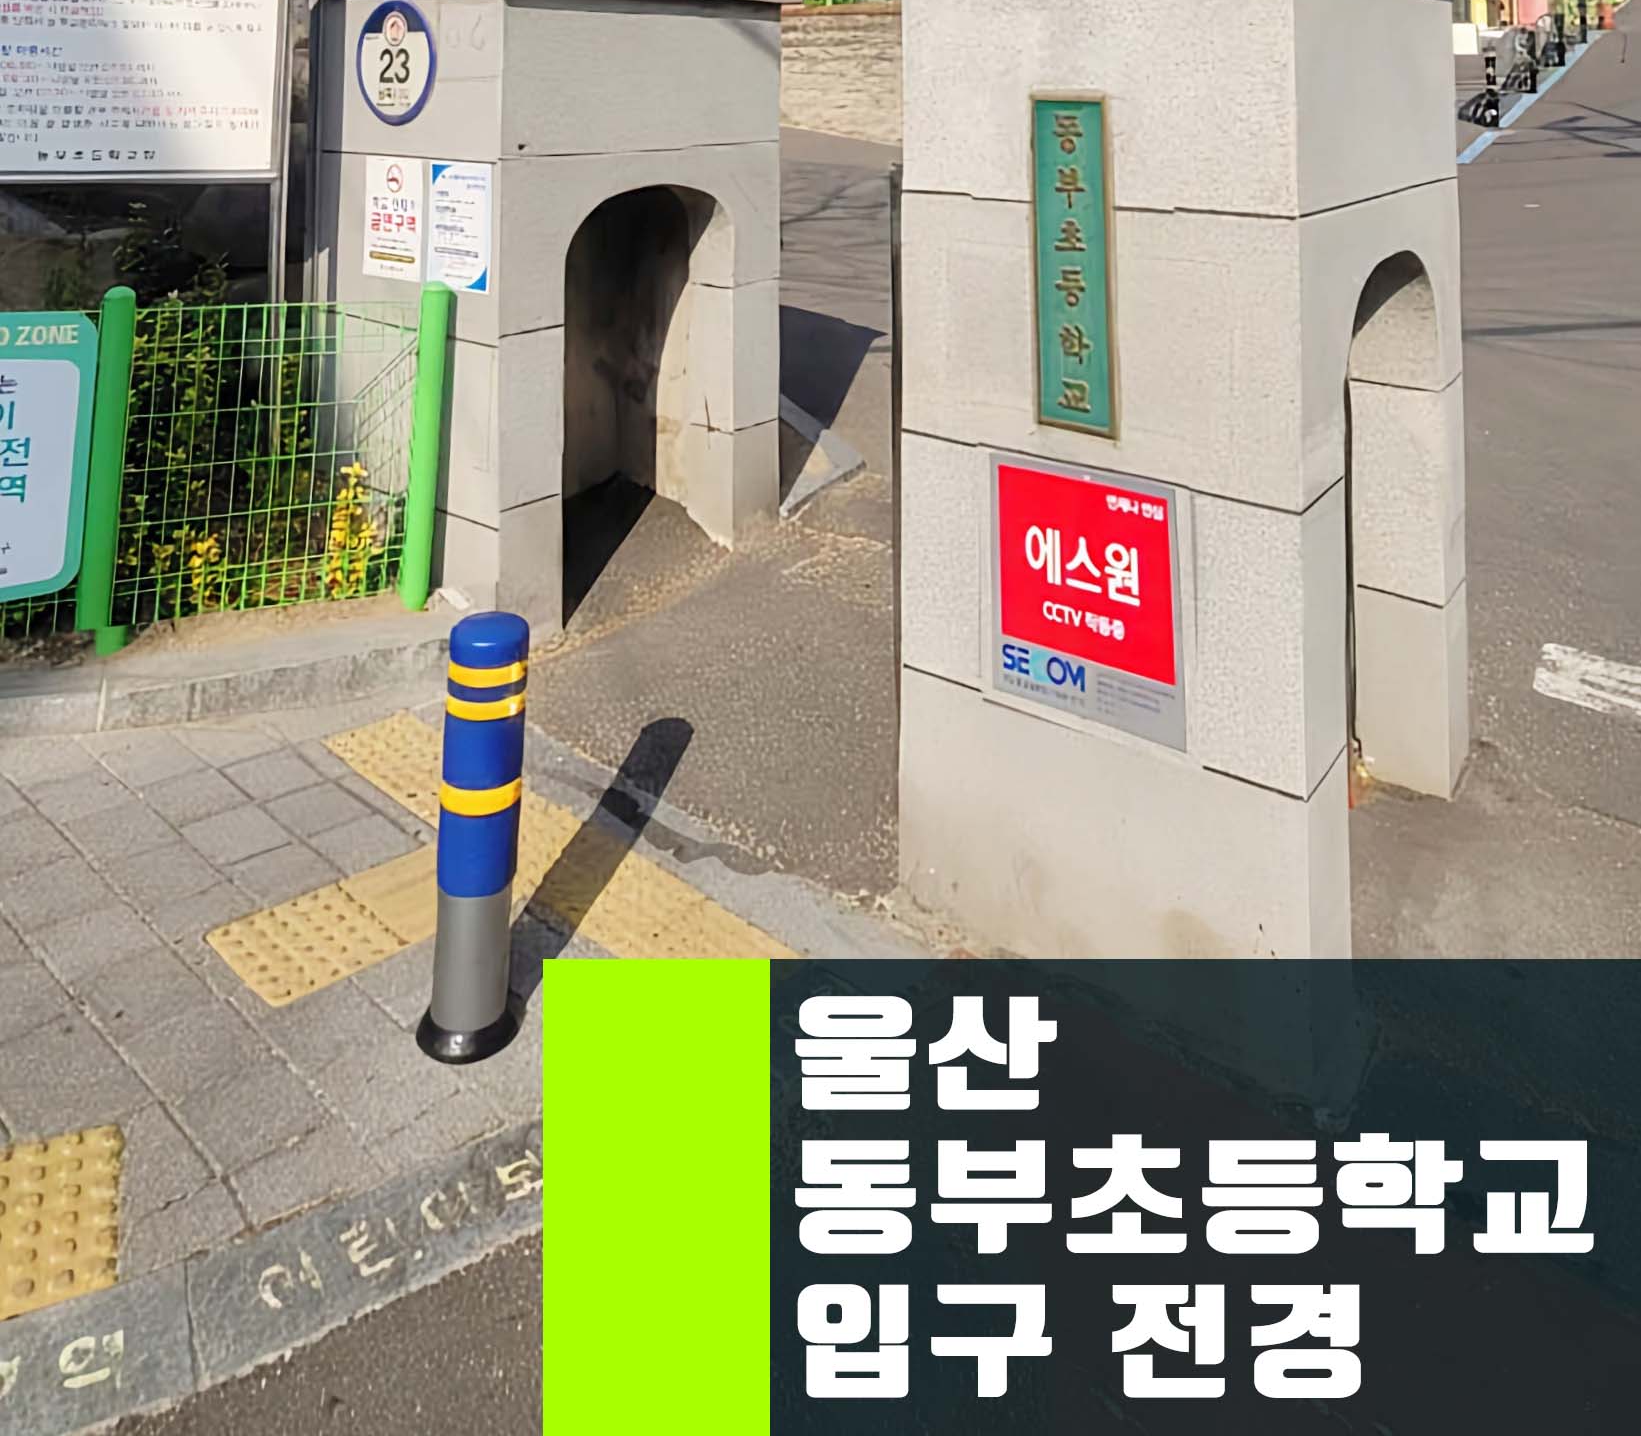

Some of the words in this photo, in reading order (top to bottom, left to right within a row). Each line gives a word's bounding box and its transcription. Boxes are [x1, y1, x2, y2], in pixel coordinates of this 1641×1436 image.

[379, 47, 411, 84] 23
[1053, 112, 1094, 413] 동부초등학교
[15, 324, 80, 346] ZONE
[1025, 525, 1141, 607] 에스원
[1042, 601, 1083, 628] CCTV
[1002, 643, 1086, 693] SECOM
